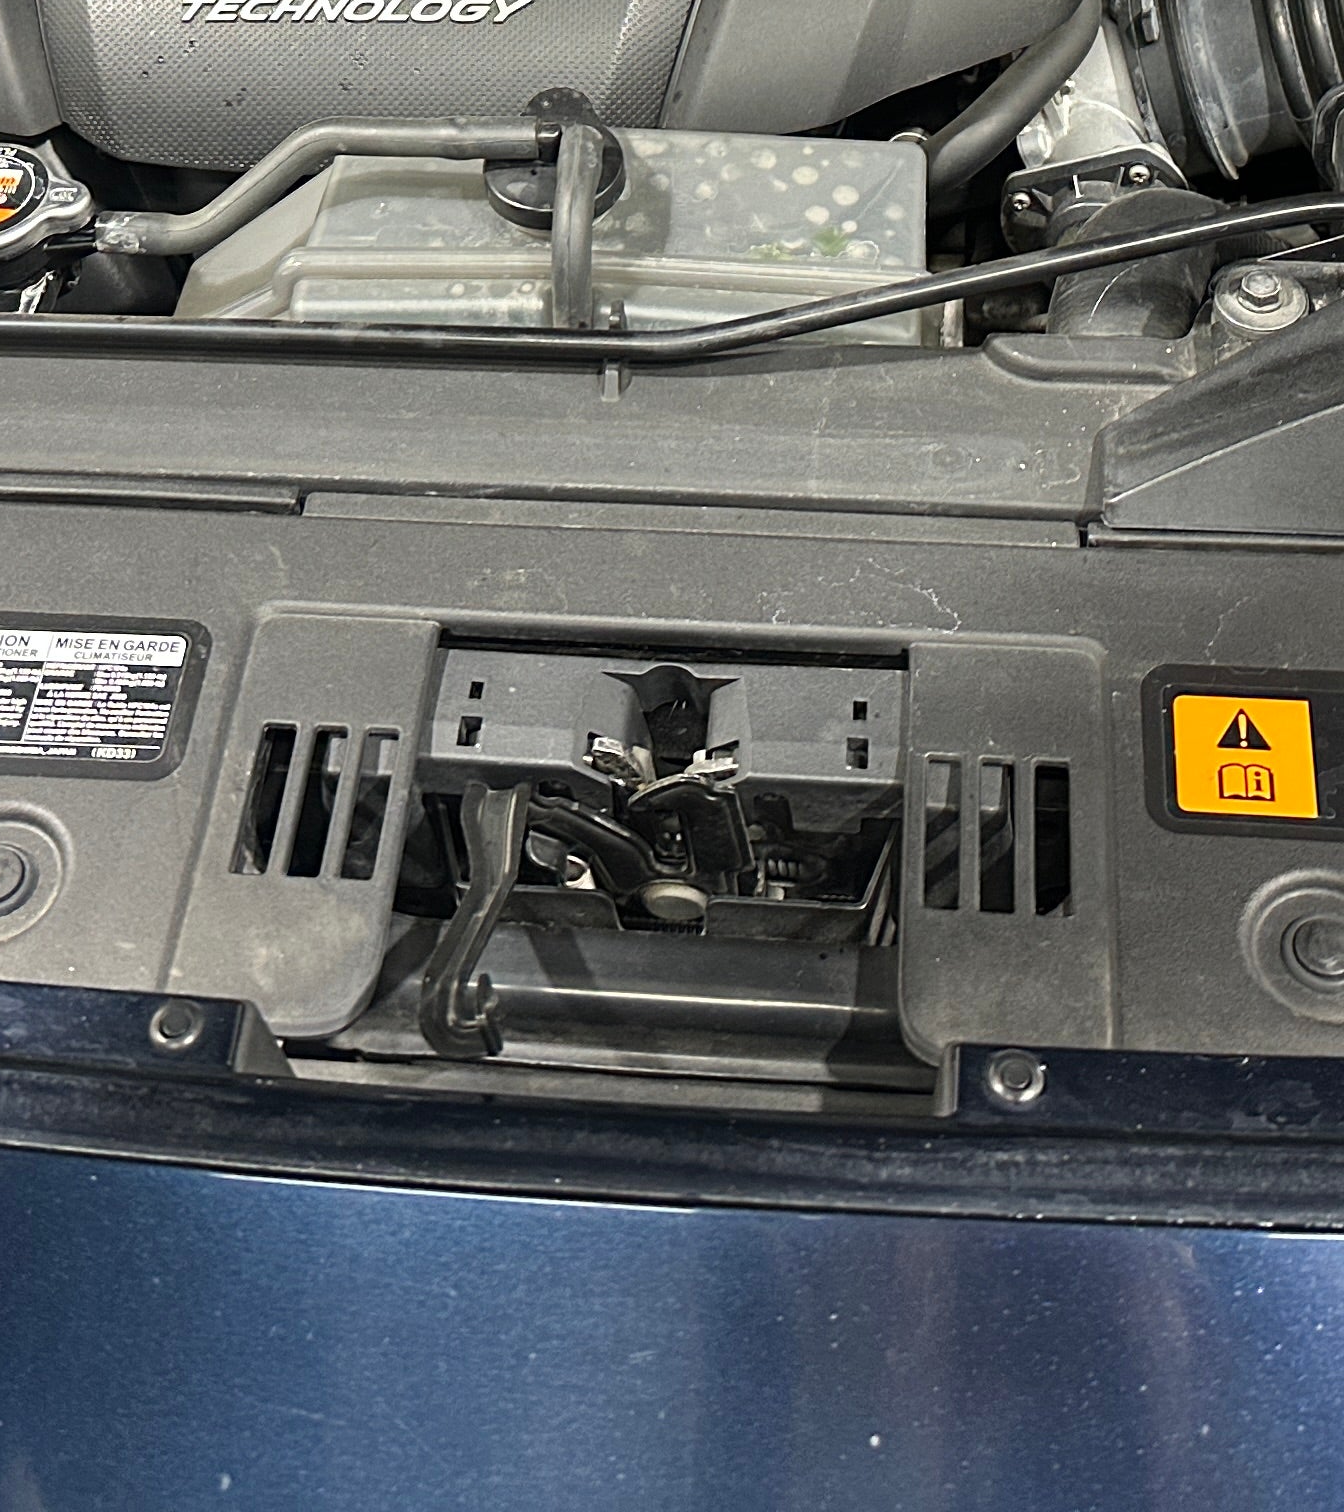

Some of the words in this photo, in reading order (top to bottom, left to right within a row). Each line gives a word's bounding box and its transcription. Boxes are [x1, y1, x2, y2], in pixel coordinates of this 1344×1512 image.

[55, 637, 95, 650] MISE
[98, 639, 120, 651] EN
[123, 639, 181, 653] GARDE
[73, 651, 153, 662] CLIMATISEUR
